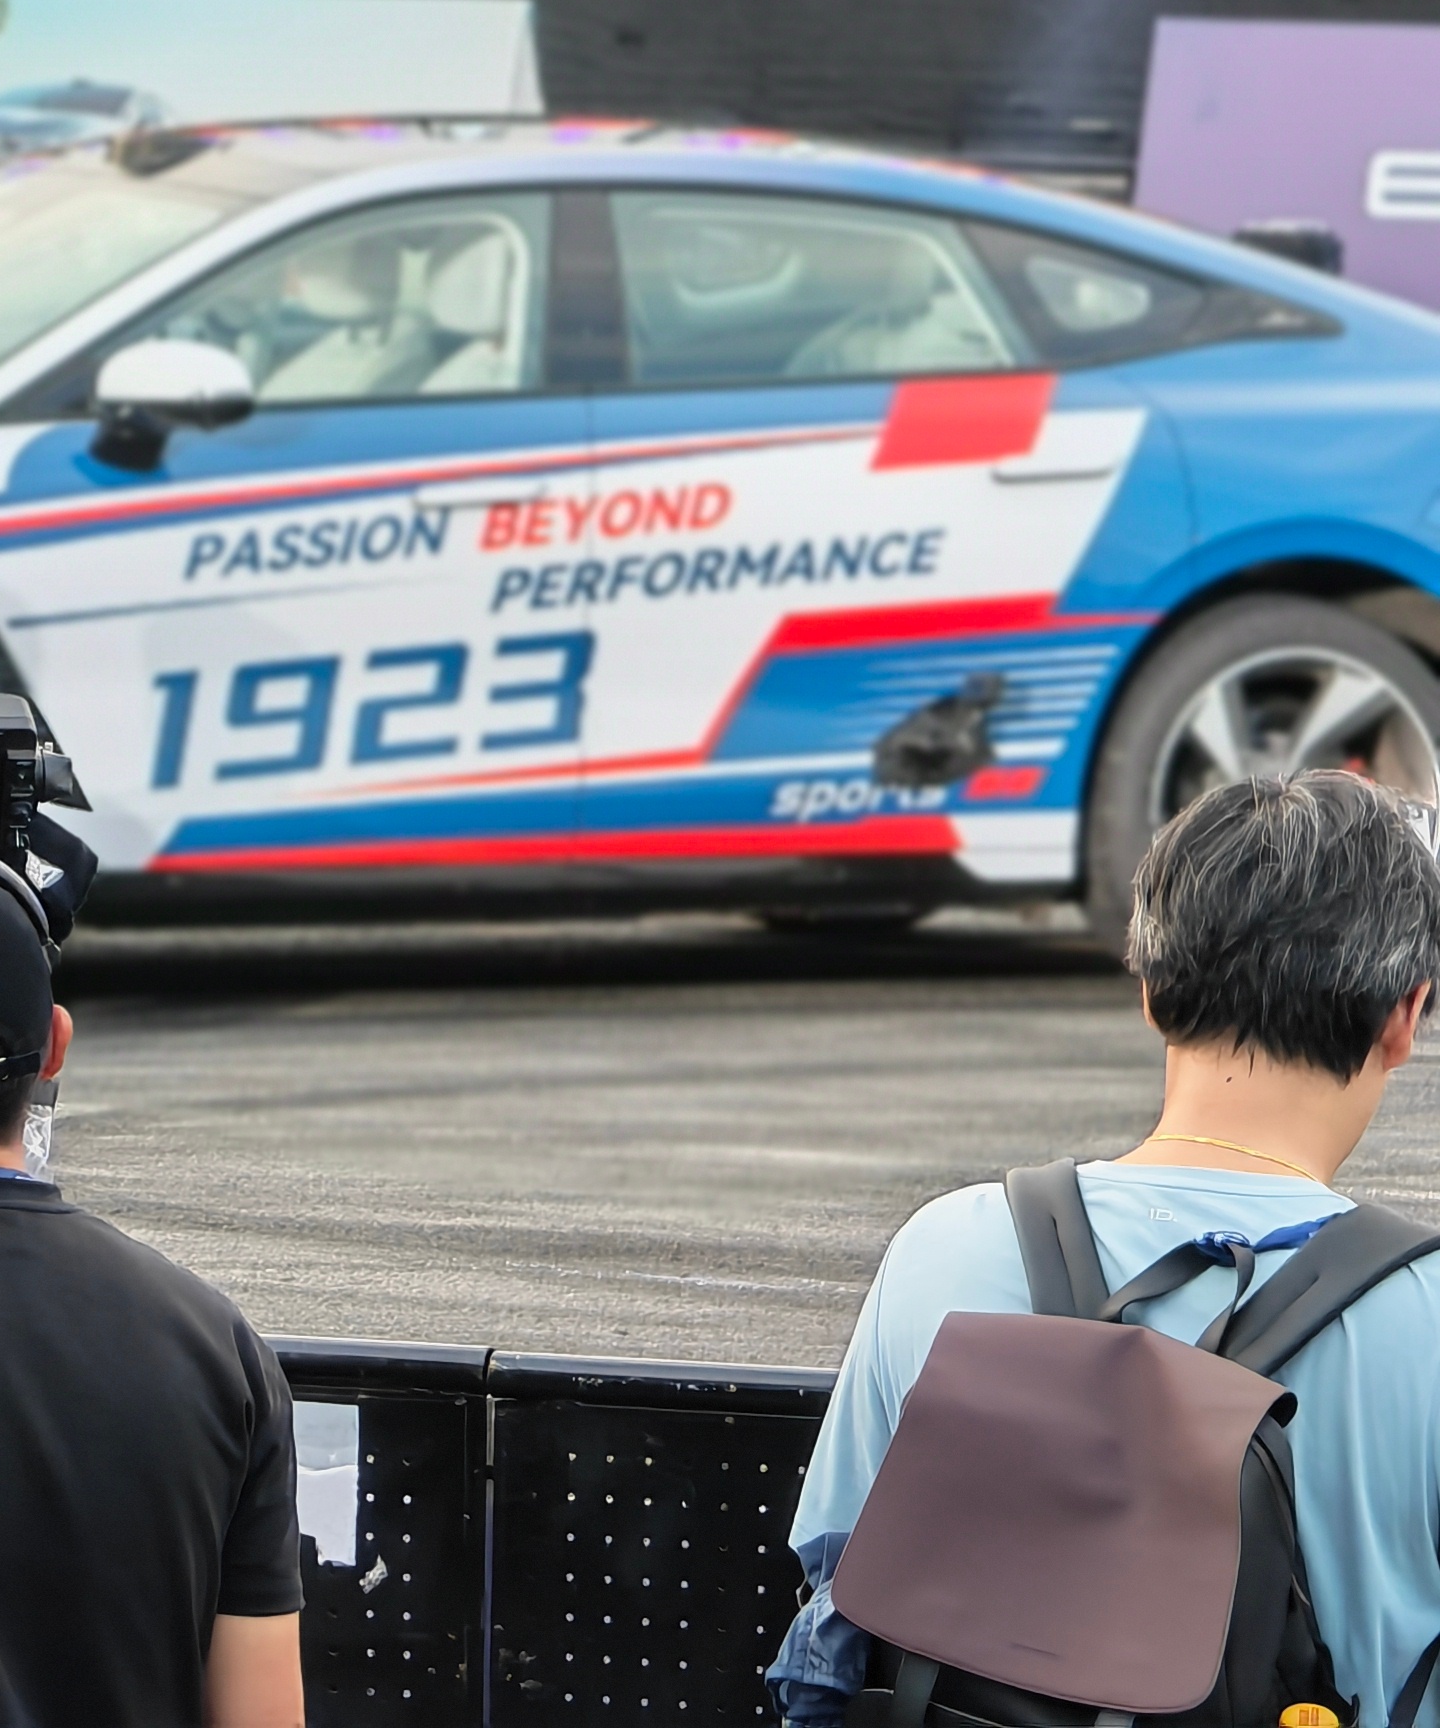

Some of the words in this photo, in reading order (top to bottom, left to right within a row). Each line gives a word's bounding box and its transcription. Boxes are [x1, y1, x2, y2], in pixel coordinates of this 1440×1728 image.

[184, 505, 452, 581] PASSION
[479, 481, 732, 552] BEYOND
[489, 528, 945, 614] PERFORMANCE
[149, 628, 597, 791] 1923
